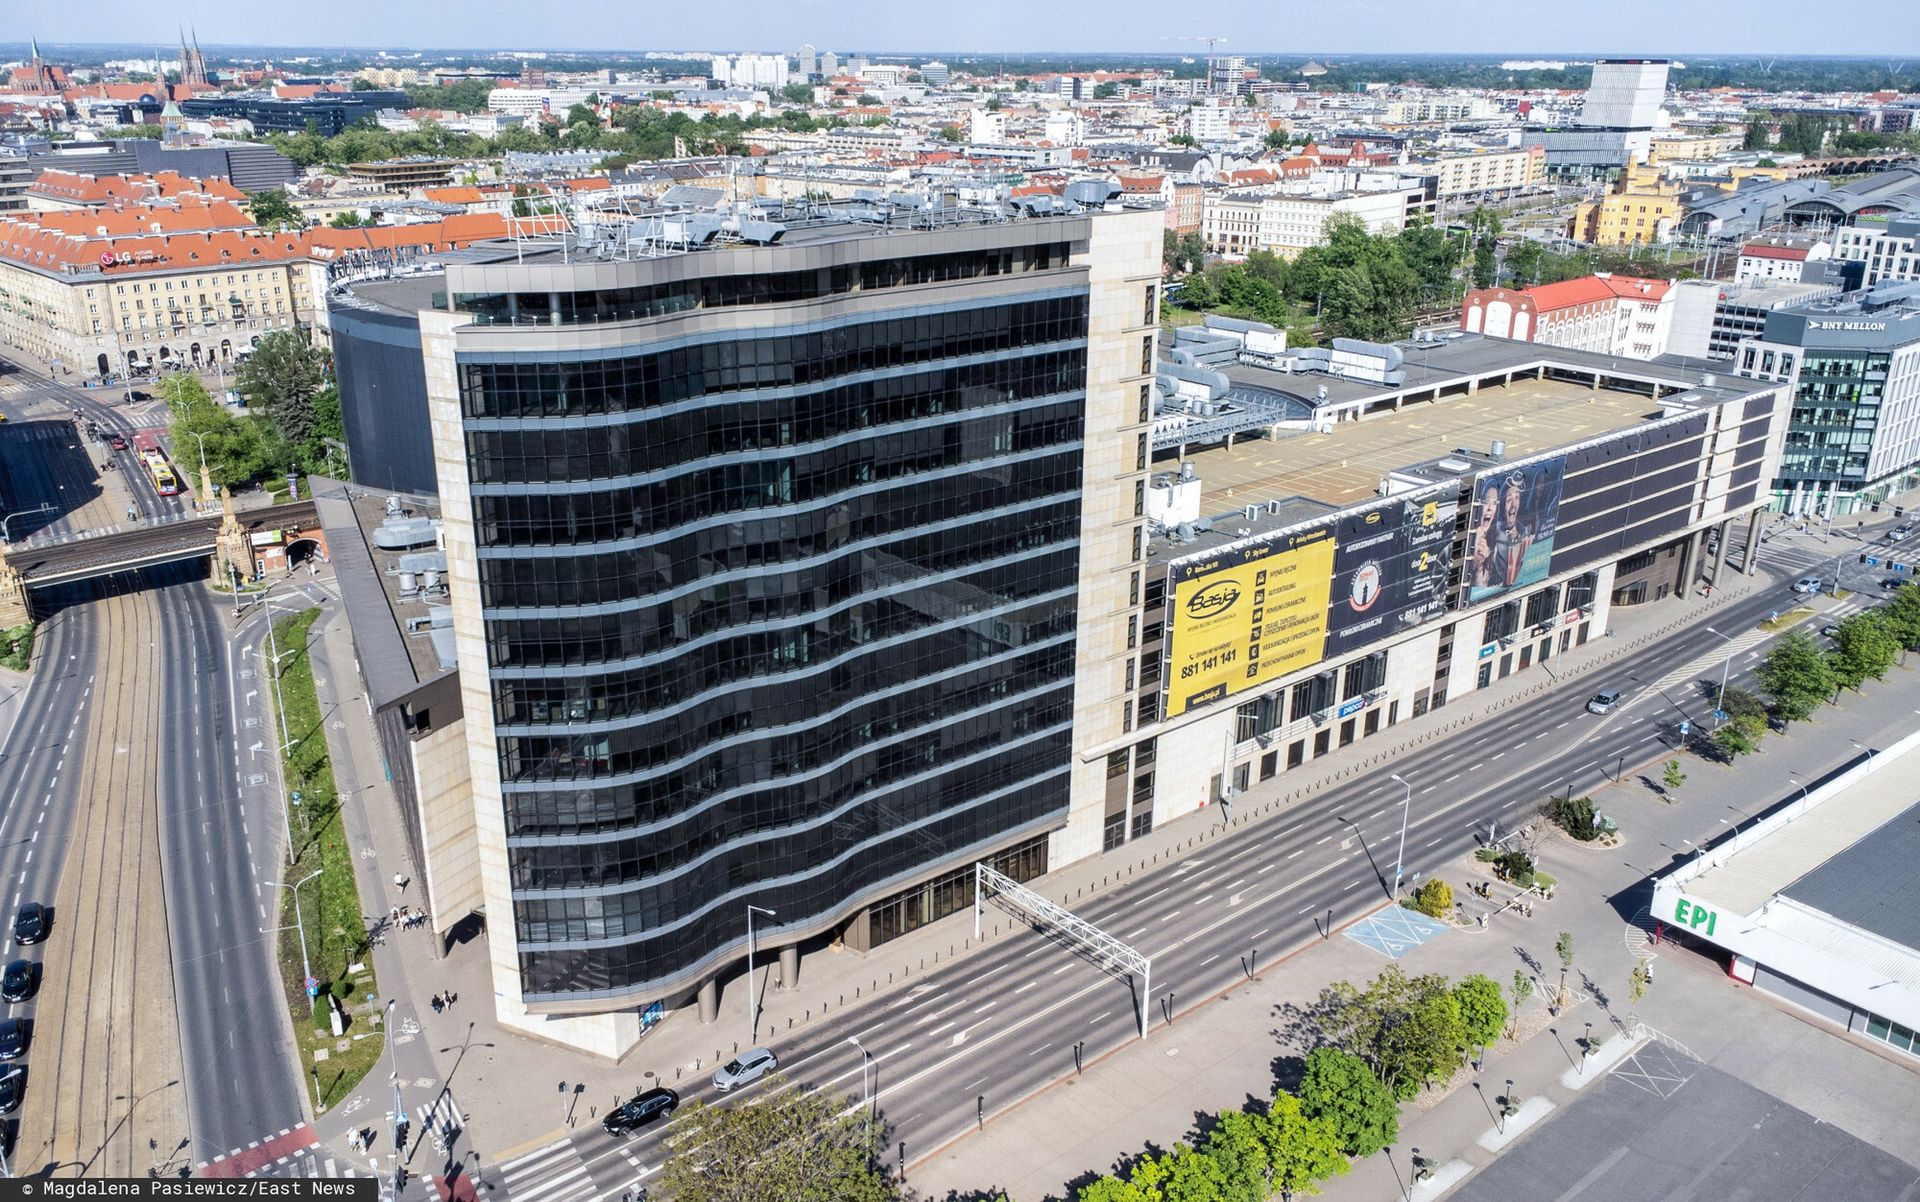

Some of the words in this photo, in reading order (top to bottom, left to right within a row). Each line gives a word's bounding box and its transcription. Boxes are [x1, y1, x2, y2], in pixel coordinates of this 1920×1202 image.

[115, 251, 131, 262] LG
[1822, 321, 1842, 330] BNY
[1843, 322, 1886, 331] MELLON
[1191, 587, 1237, 612] Basja
[1181, 662, 1199, 679] 881
[1202, 655, 1218, 671] 141
[1220, 648, 1236, 665] 141
[1343, 700, 1365, 715] pepco
[1674, 898, 1718, 937] EPI
